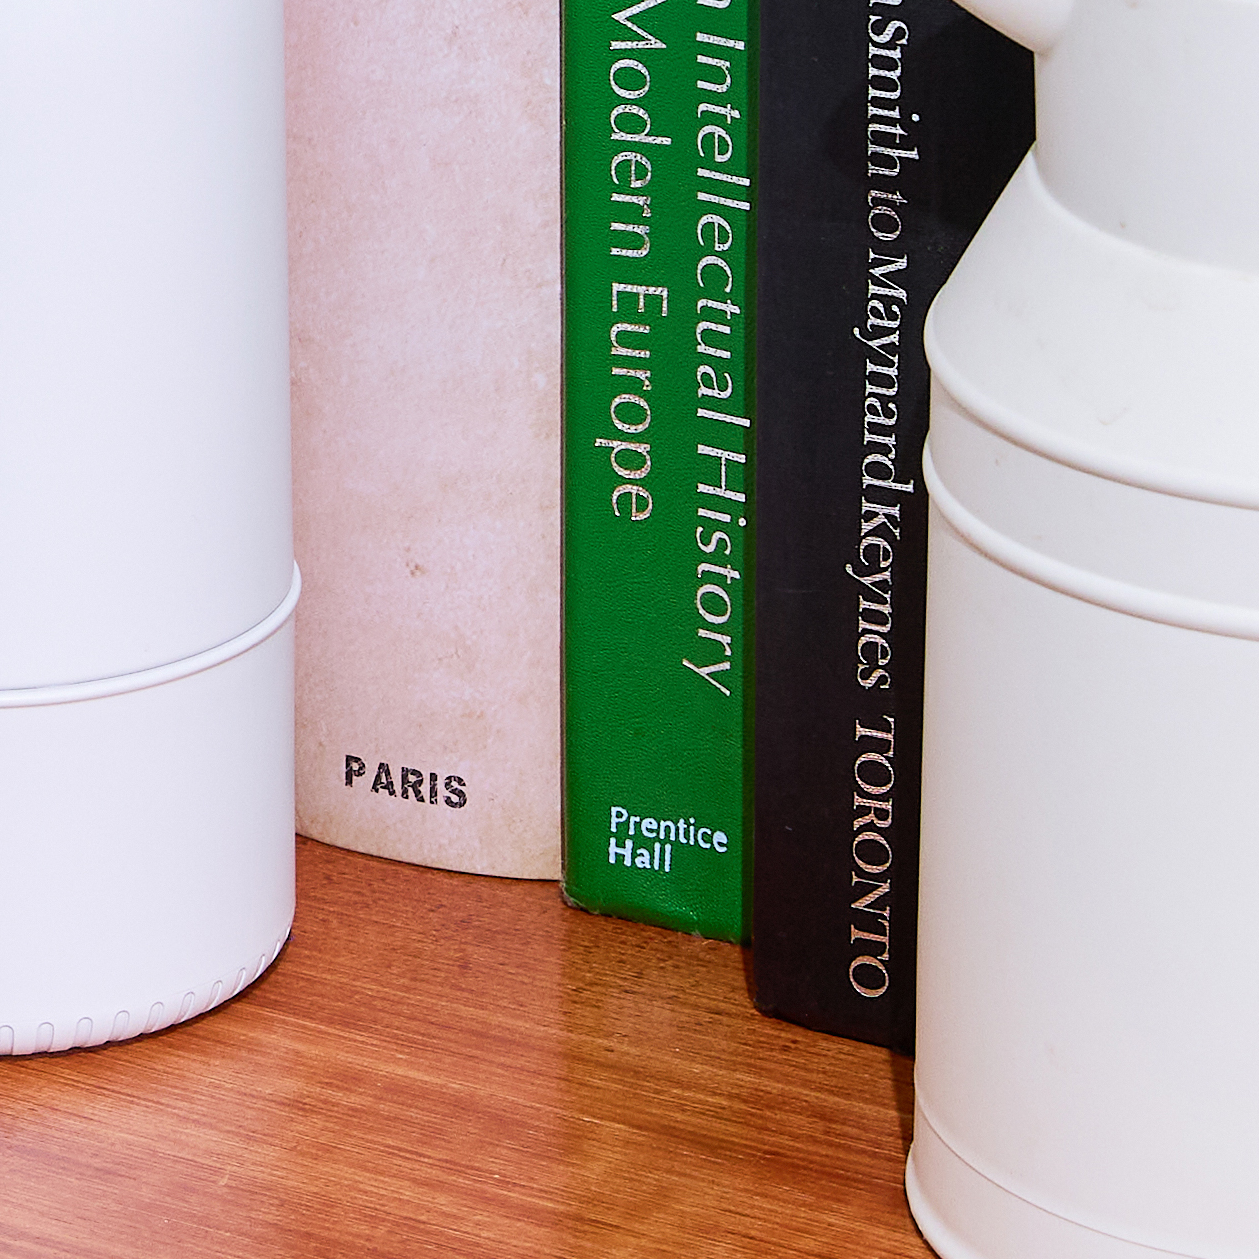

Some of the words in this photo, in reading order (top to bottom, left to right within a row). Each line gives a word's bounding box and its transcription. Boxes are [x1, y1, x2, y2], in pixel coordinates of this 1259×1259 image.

[866, 13, 921, 178] Smith
[694, 30, 752, 429] Intellectual
[866, 188, 909, 242] to
[594, 281, 669, 522] Europe
[852, 247, 915, 494] Maynard
[681, 443, 748, 698] History
[844, 496, 902, 691] Keynes
[343, 754, 468, 809] PARIS
[607, 837, 673, 873] Hall
[608, 806, 729, 853] Prentice
[847, 714, 896, 999] TORONTO
